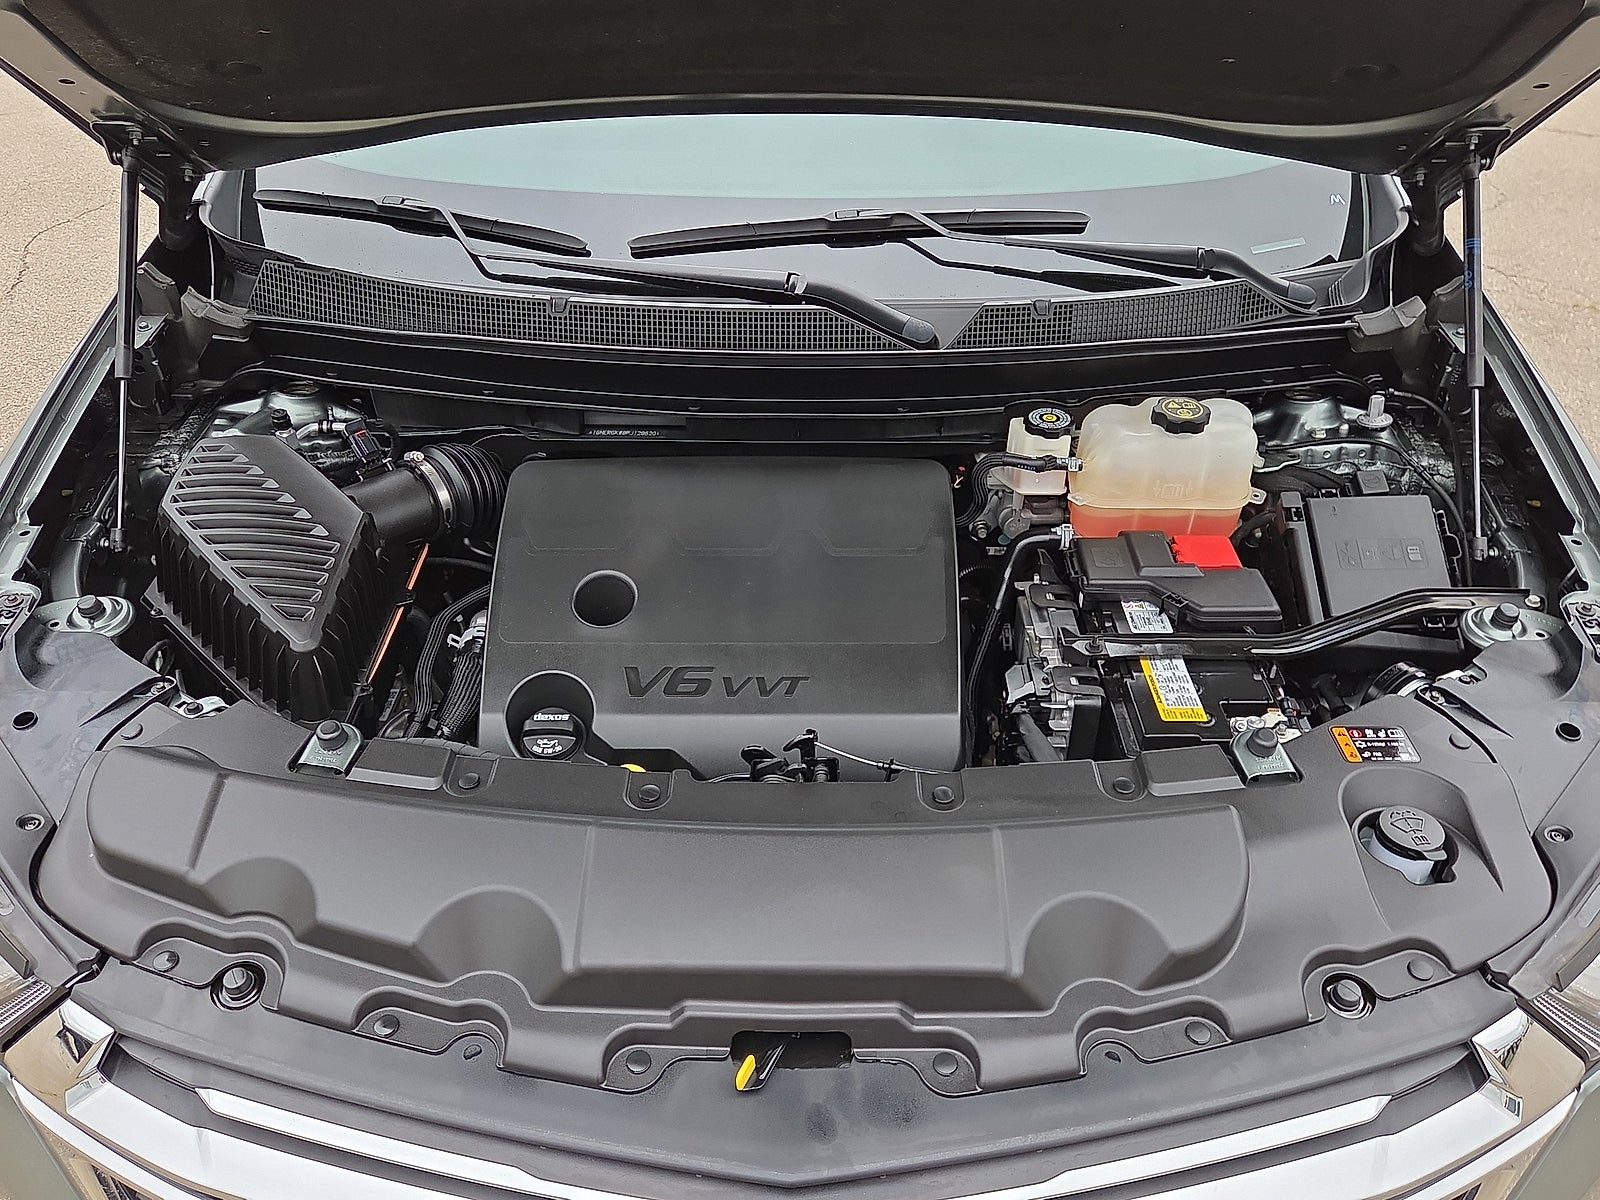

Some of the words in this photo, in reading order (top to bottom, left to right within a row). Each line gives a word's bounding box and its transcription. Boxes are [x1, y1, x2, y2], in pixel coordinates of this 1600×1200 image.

[623, 666, 715, 698] V6
[722, 676, 810, 698] VVT
[533, 713, 570, 721] dexos
